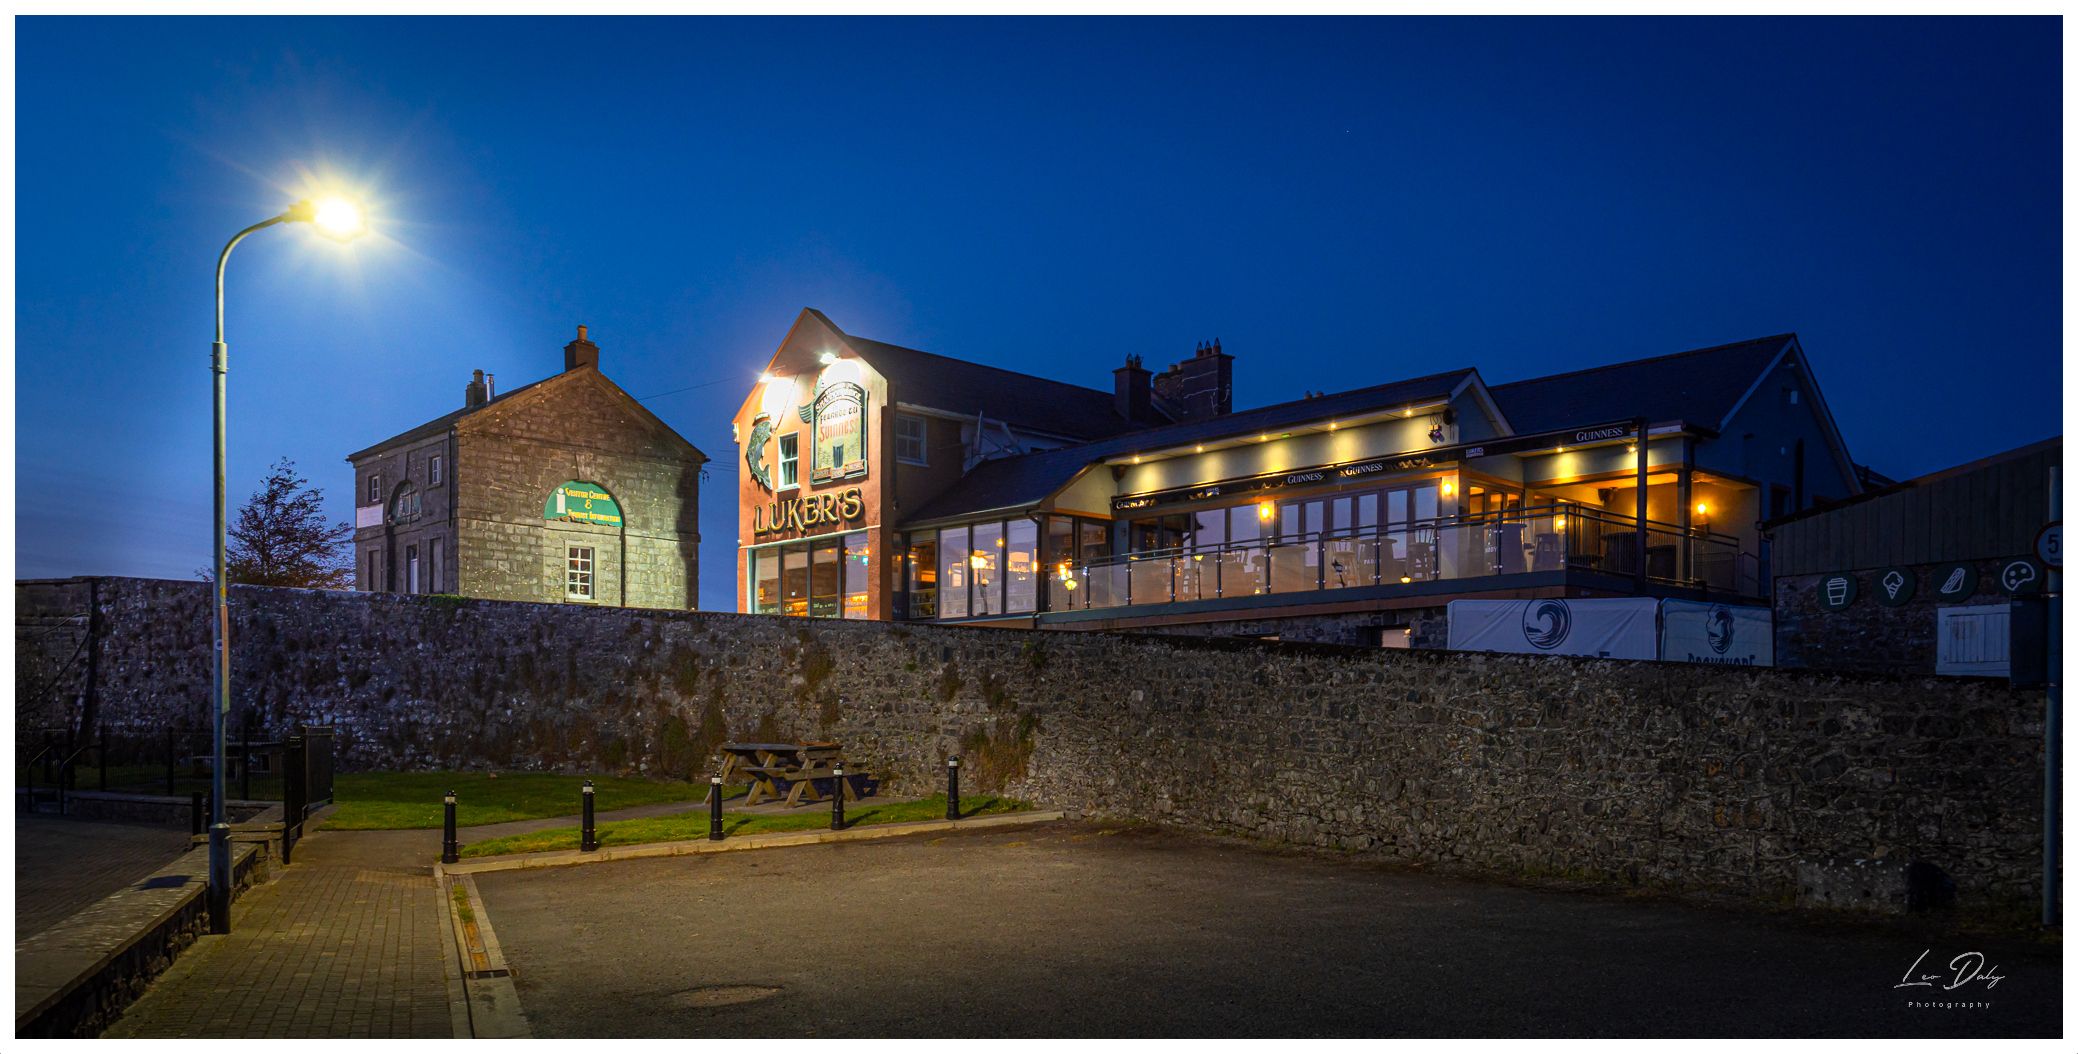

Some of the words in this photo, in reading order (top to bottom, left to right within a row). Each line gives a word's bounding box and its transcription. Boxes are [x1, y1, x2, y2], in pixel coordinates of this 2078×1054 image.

[1576, 427, 1624, 442] GUINNESS
[1345, 463, 1383, 476] GUINNESS
[1288, 472, 1323, 485] GUINNESS
[754, 487, 863, 534] LUKER'S
